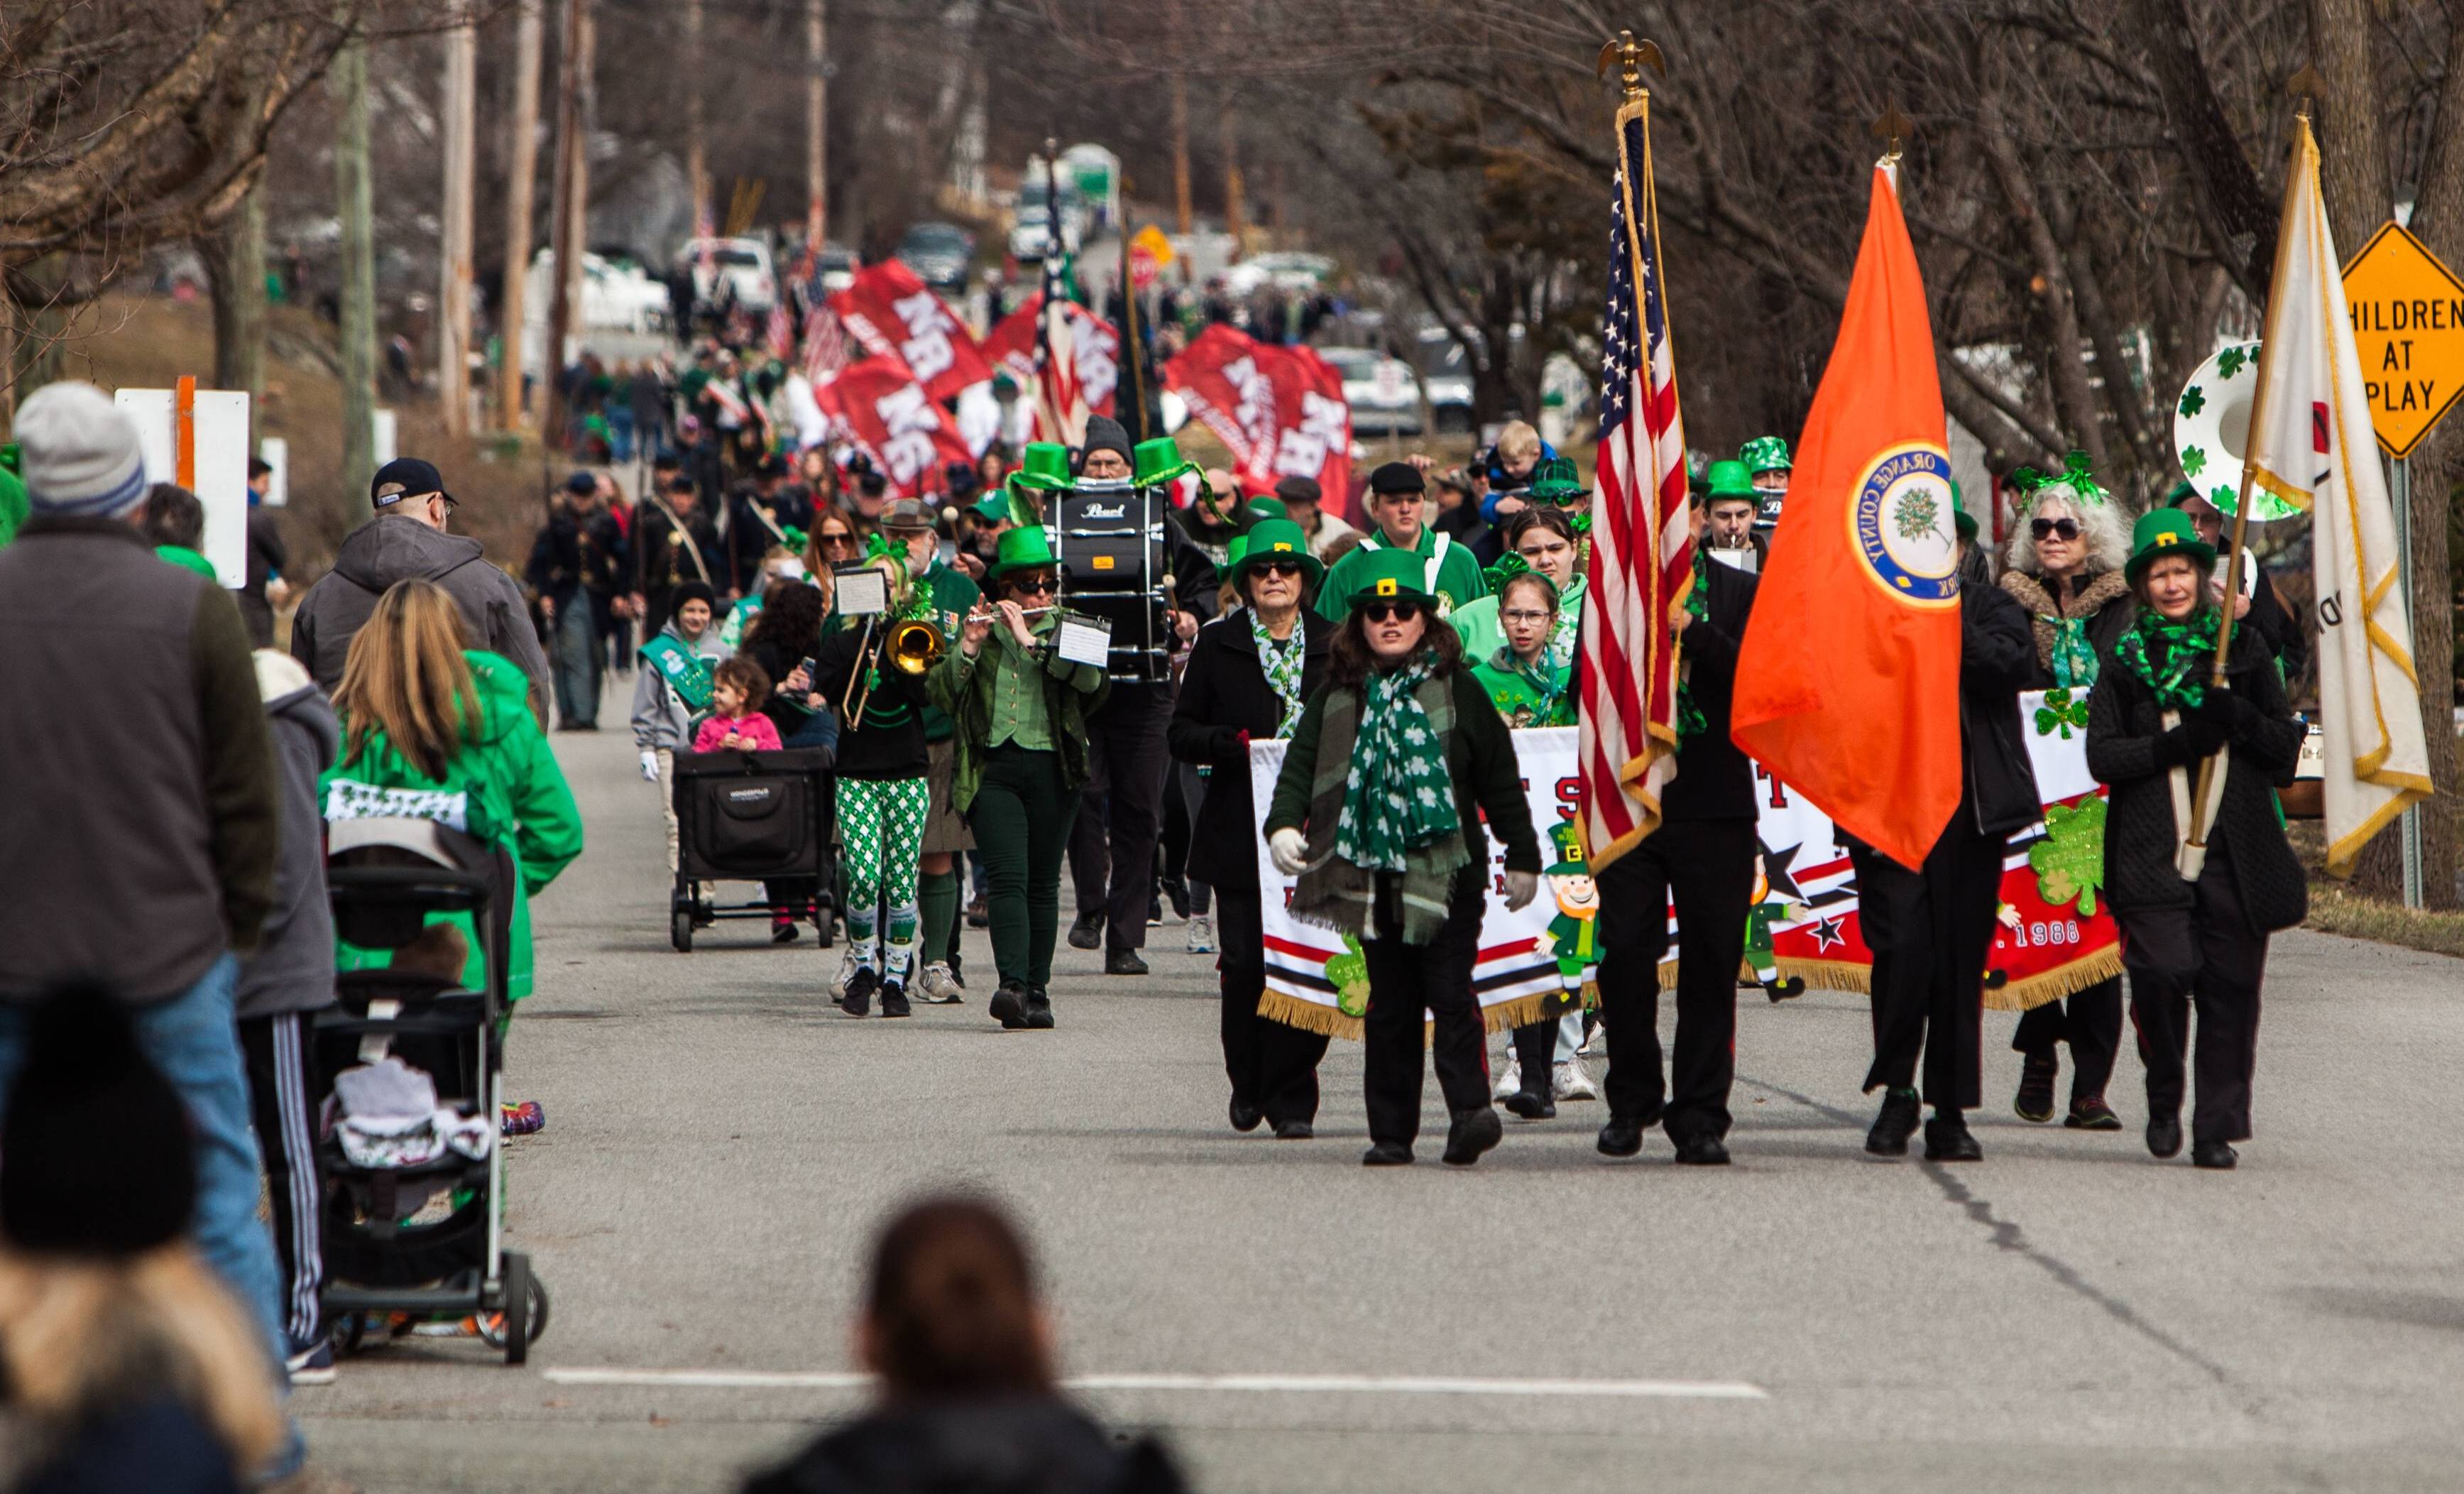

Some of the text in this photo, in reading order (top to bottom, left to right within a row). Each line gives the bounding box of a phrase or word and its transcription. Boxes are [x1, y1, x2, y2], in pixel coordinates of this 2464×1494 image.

[2350, 299, 2464, 332] HILDREN
[2383, 341, 2414, 371] AT
[2365, 380, 2434, 411] PLAY
[1080, 503, 1125, 520] Pearl
[2015, 920, 2080, 948] 1988
